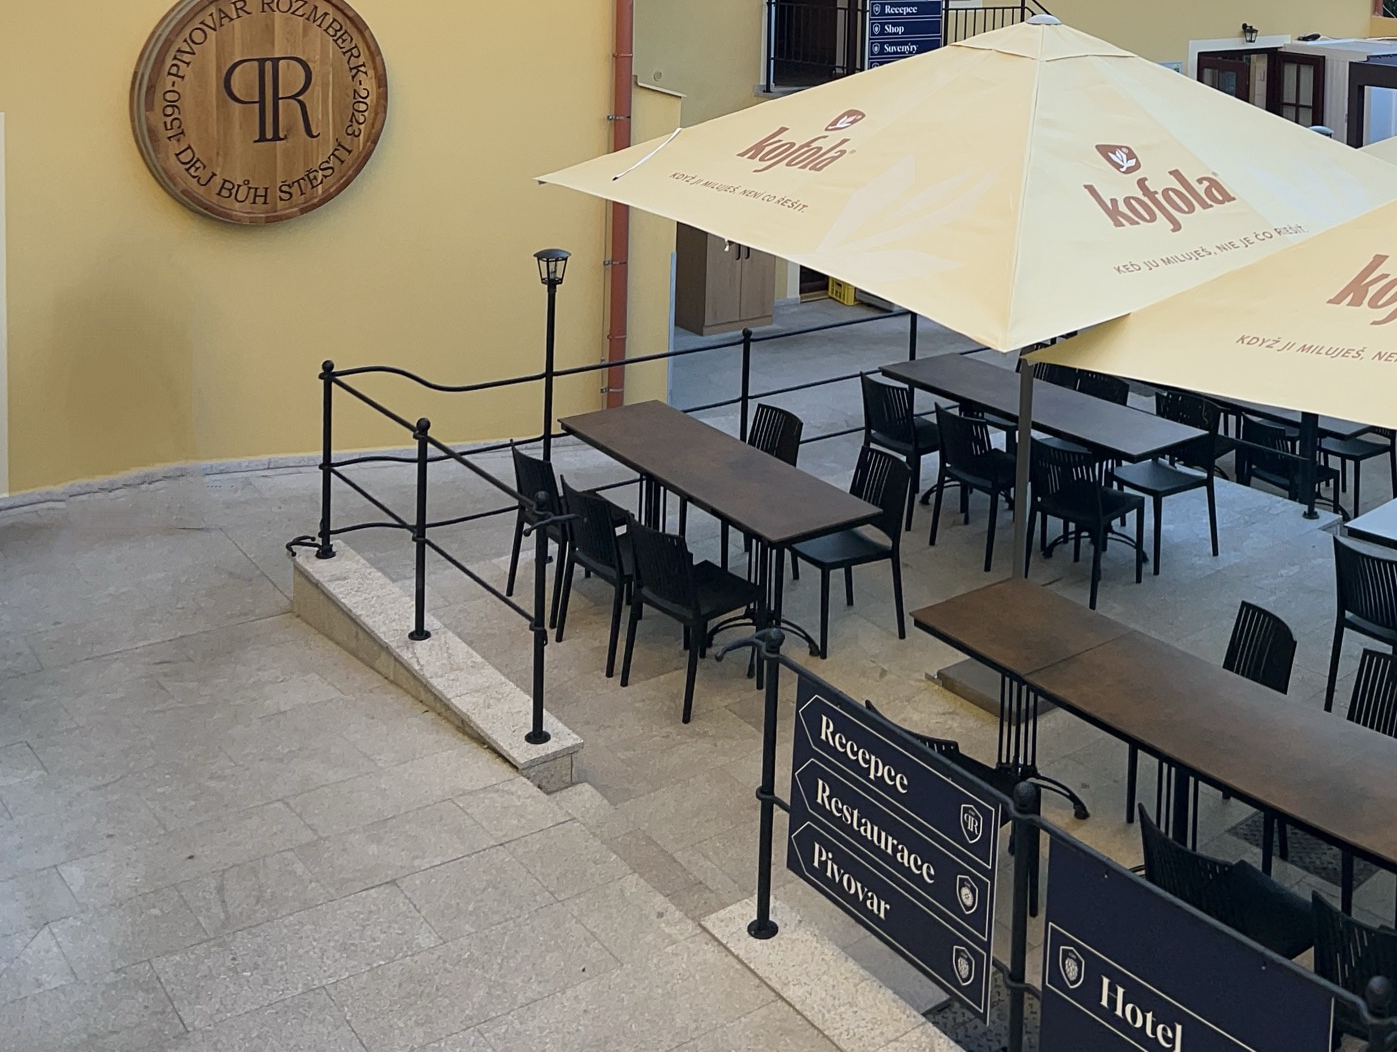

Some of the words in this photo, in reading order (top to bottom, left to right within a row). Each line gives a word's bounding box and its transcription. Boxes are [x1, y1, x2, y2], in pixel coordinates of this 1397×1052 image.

[884, 24, 904, 34] Shop
[885, 5, 917, 15] Recepce
[884, 43, 918, 53] Suvenýry
[175, 144, 217, 187] DEJ
[216, 179, 269, 204] BŮH
[278, 138, 353, 202] ŠTĚSTÍ
[736, 126, 851, 173] kofola
[669, 171, 698, 183] KDYŽ
[739, 189, 766, 200] NENÍ
[761, 194, 777, 202] CO
[774, 195, 809, 213] ŘEŠIT.
[1083, 169, 1237, 233] kofola
[1143, 260, 1159, 271] JU
[1161, 246, 1217, 266] MILUJEŠ,
[1216, 241, 1240, 253] NIE
[1239, 237, 1255, 248] JE
[1253, 231, 1273, 241] ČO
[1235, 334, 1281, 348] KDYŽ
[1277, 342, 1296, 352] JI
[1296, 343, 1367, 360] MILUJEŠ,
[819, 714, 909, 794] Recepce
[816, 777, 936, 884] Restaurace
[813, 842, 890, 921] Pivovar
[1100, 975, 1182, 1052] Hotel
